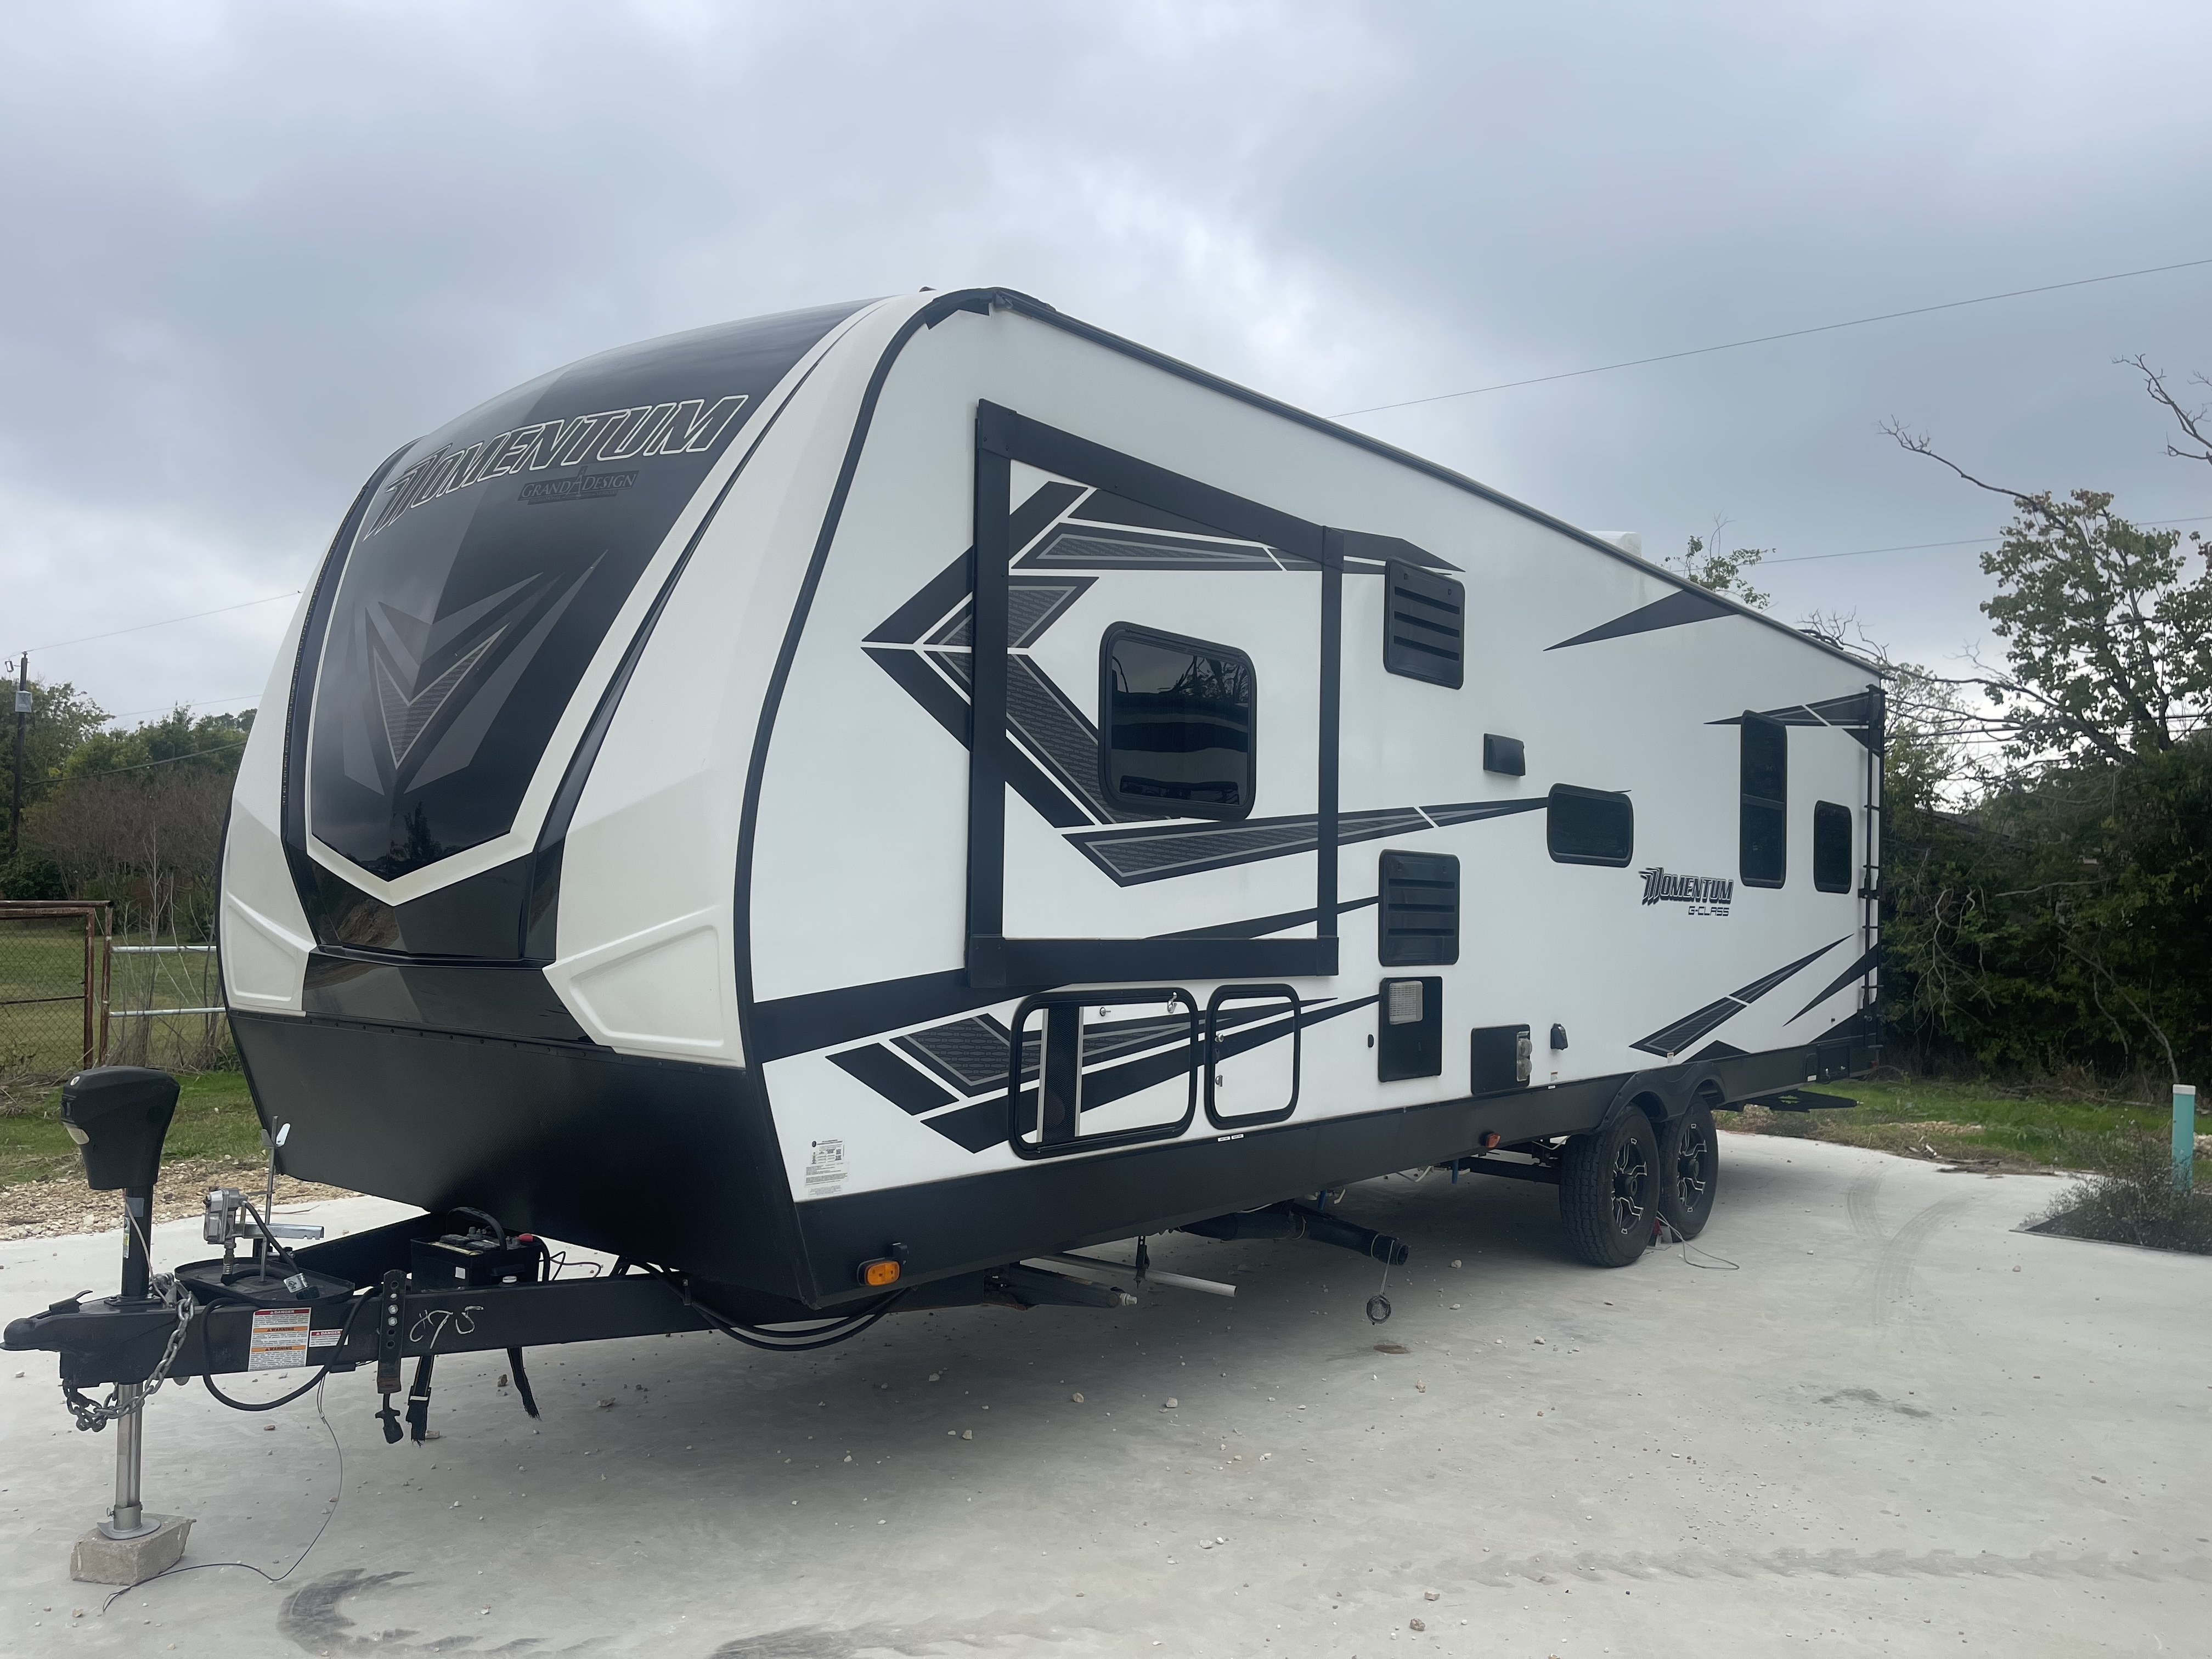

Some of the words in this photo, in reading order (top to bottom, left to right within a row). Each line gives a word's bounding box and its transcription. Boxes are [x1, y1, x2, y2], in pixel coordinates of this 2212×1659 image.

[363, 395, 749, 542] MOMENTUM
[521, 481, 571, 498] GRAND
[582, 473, 637, 491] DESIGN
[1638, 867, 1734, 906] MOMENTUM
[1688, 906, 1730, 916] G-CLASS
